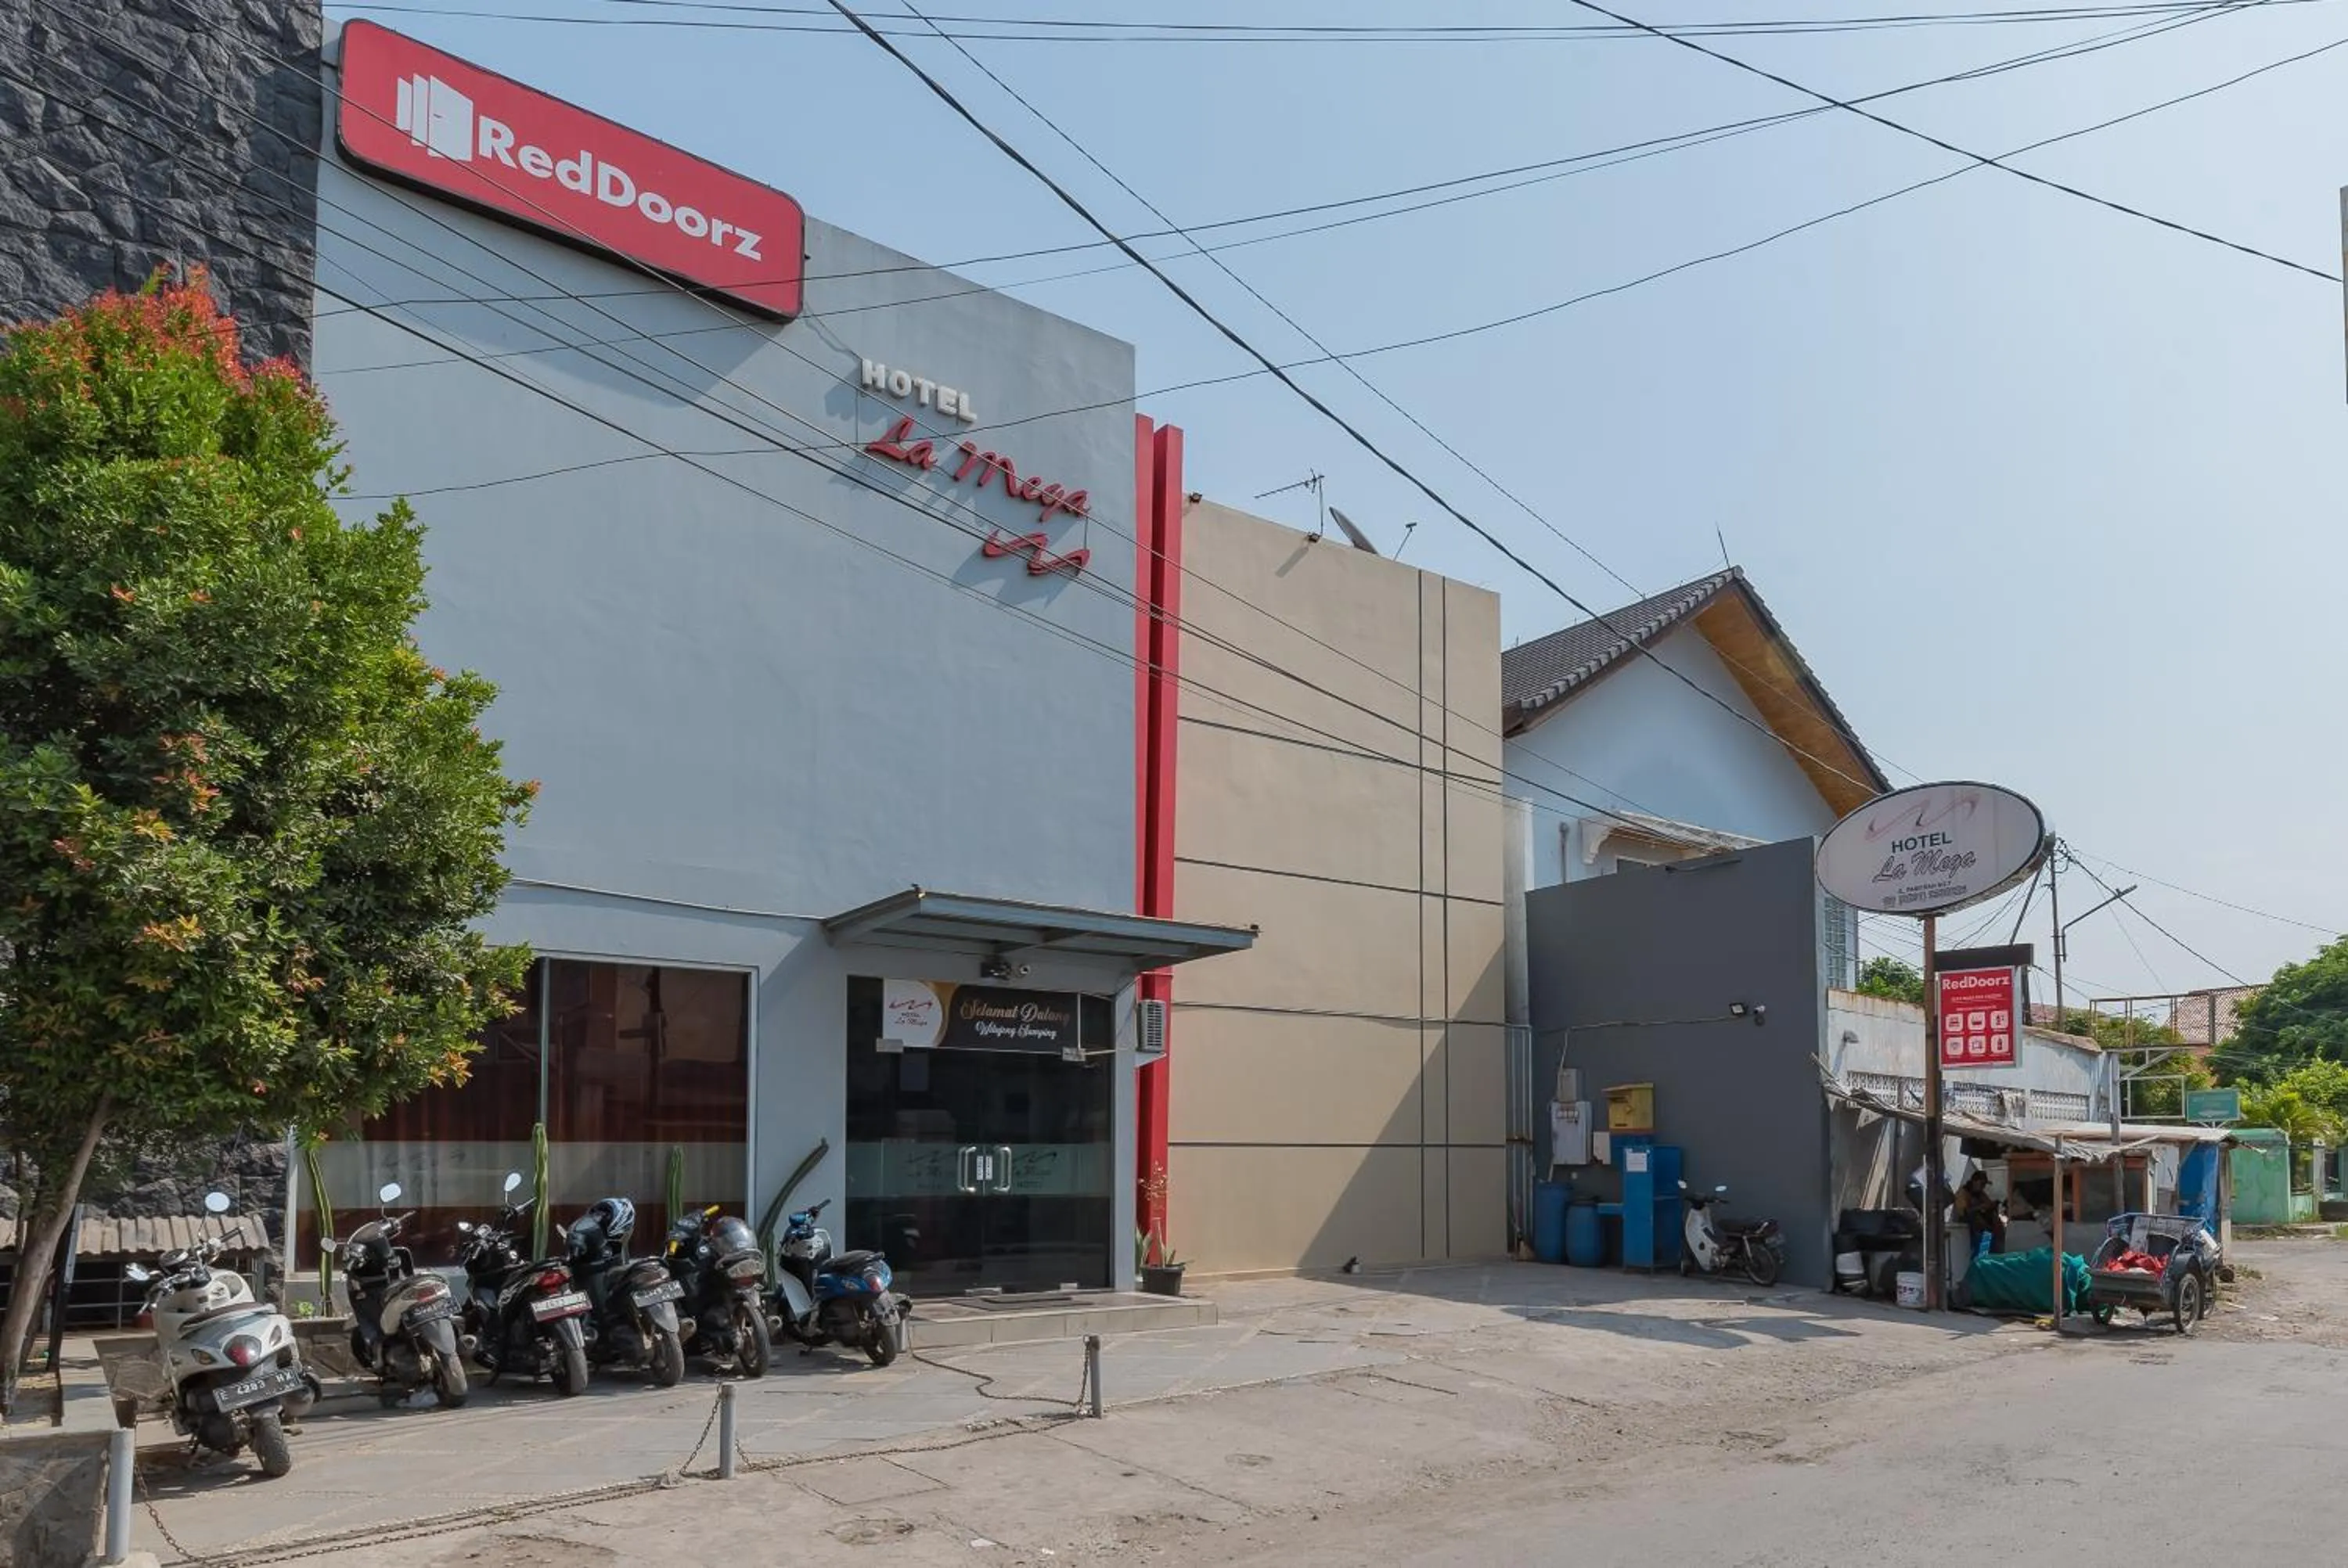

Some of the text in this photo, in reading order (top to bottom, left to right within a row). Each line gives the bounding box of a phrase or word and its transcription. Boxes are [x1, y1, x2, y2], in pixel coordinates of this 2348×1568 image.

[478, 114, 762, 261] RedDoorz
[862, 358, 977, 423] HOTEL
[864, 415, 1091, 522] La Mega
[1871, 849, 1977, 883] La Mega
[1891, 831, 1953, 853] HOTEL
[1942, 976, 2011, 991] RedDoorz
